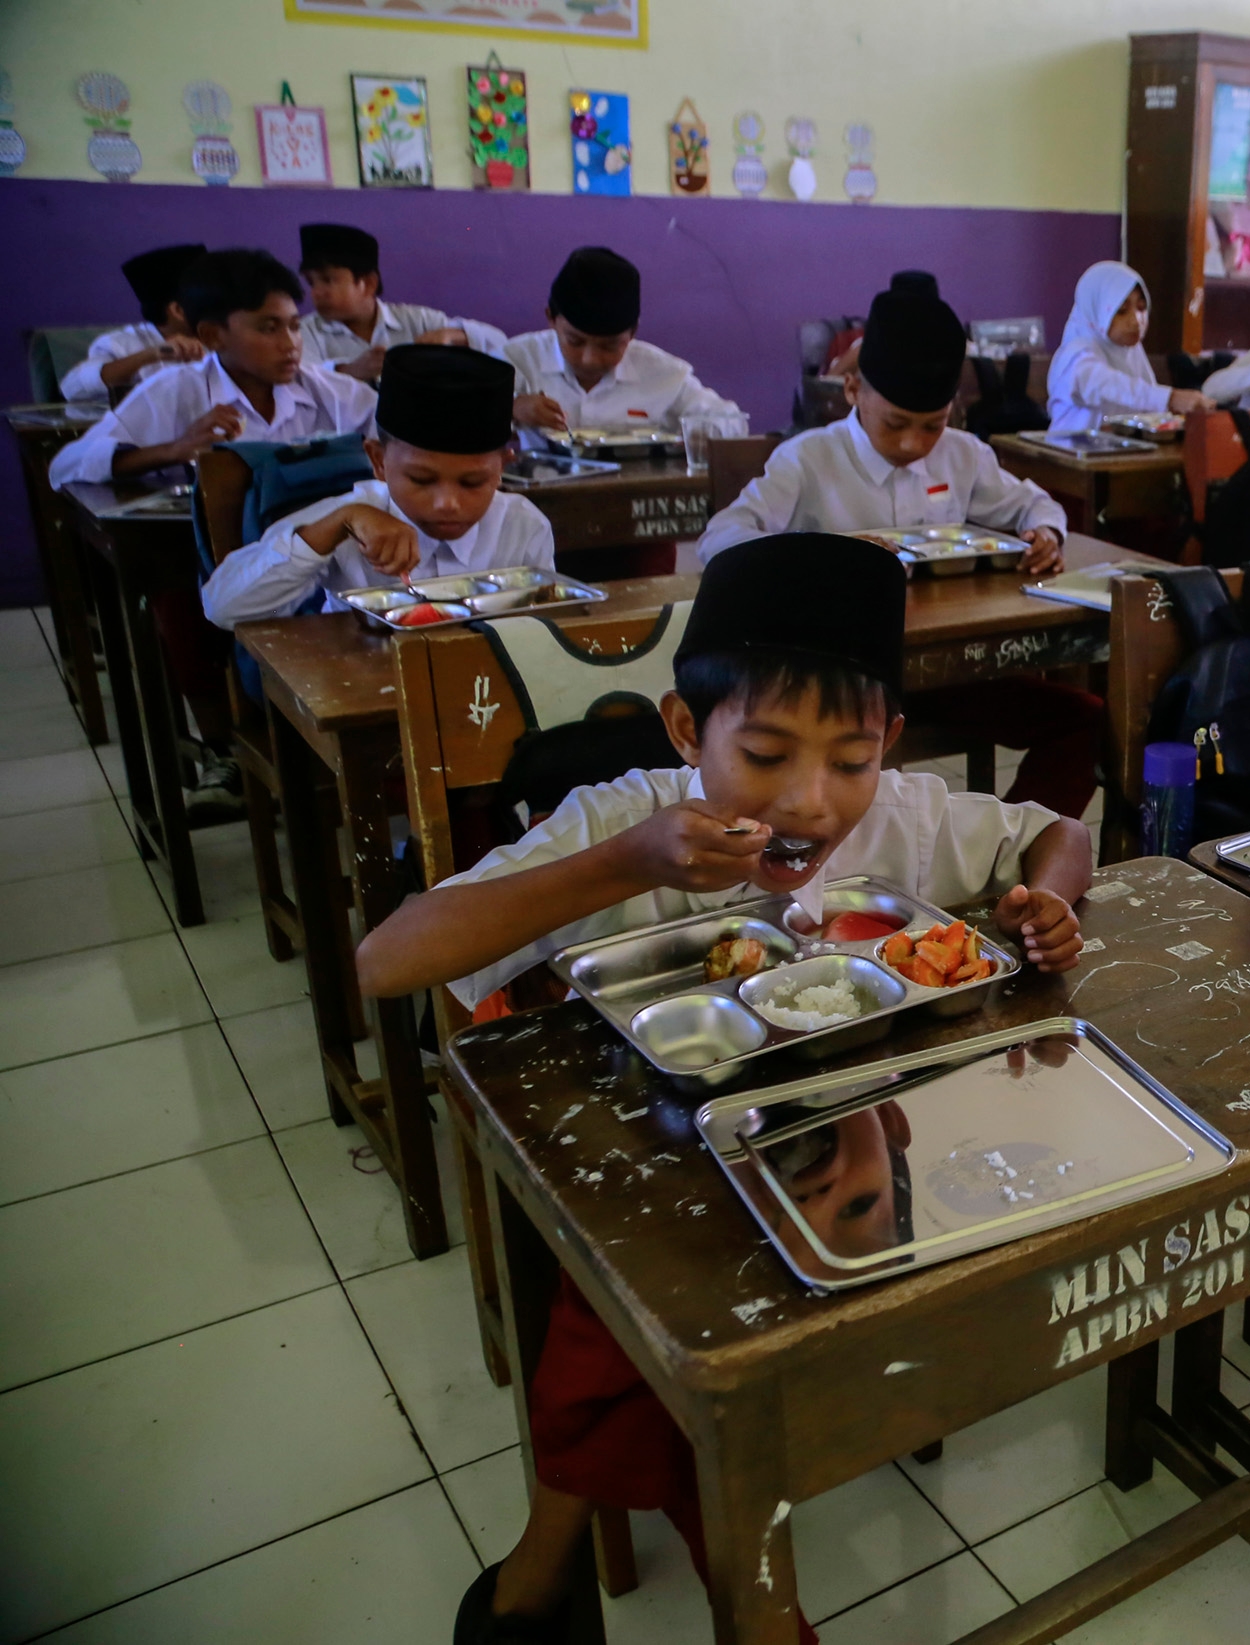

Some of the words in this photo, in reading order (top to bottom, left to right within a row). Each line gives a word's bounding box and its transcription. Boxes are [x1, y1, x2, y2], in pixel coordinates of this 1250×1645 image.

[631, 496, 669, 518] MIN
[674, 494, 709, 516] SAS
[634, 518, 679, 537] APBN
[1047, 1237, 1150, 1325] MIN
[1055, 1286, 1169, 1369] APBN
